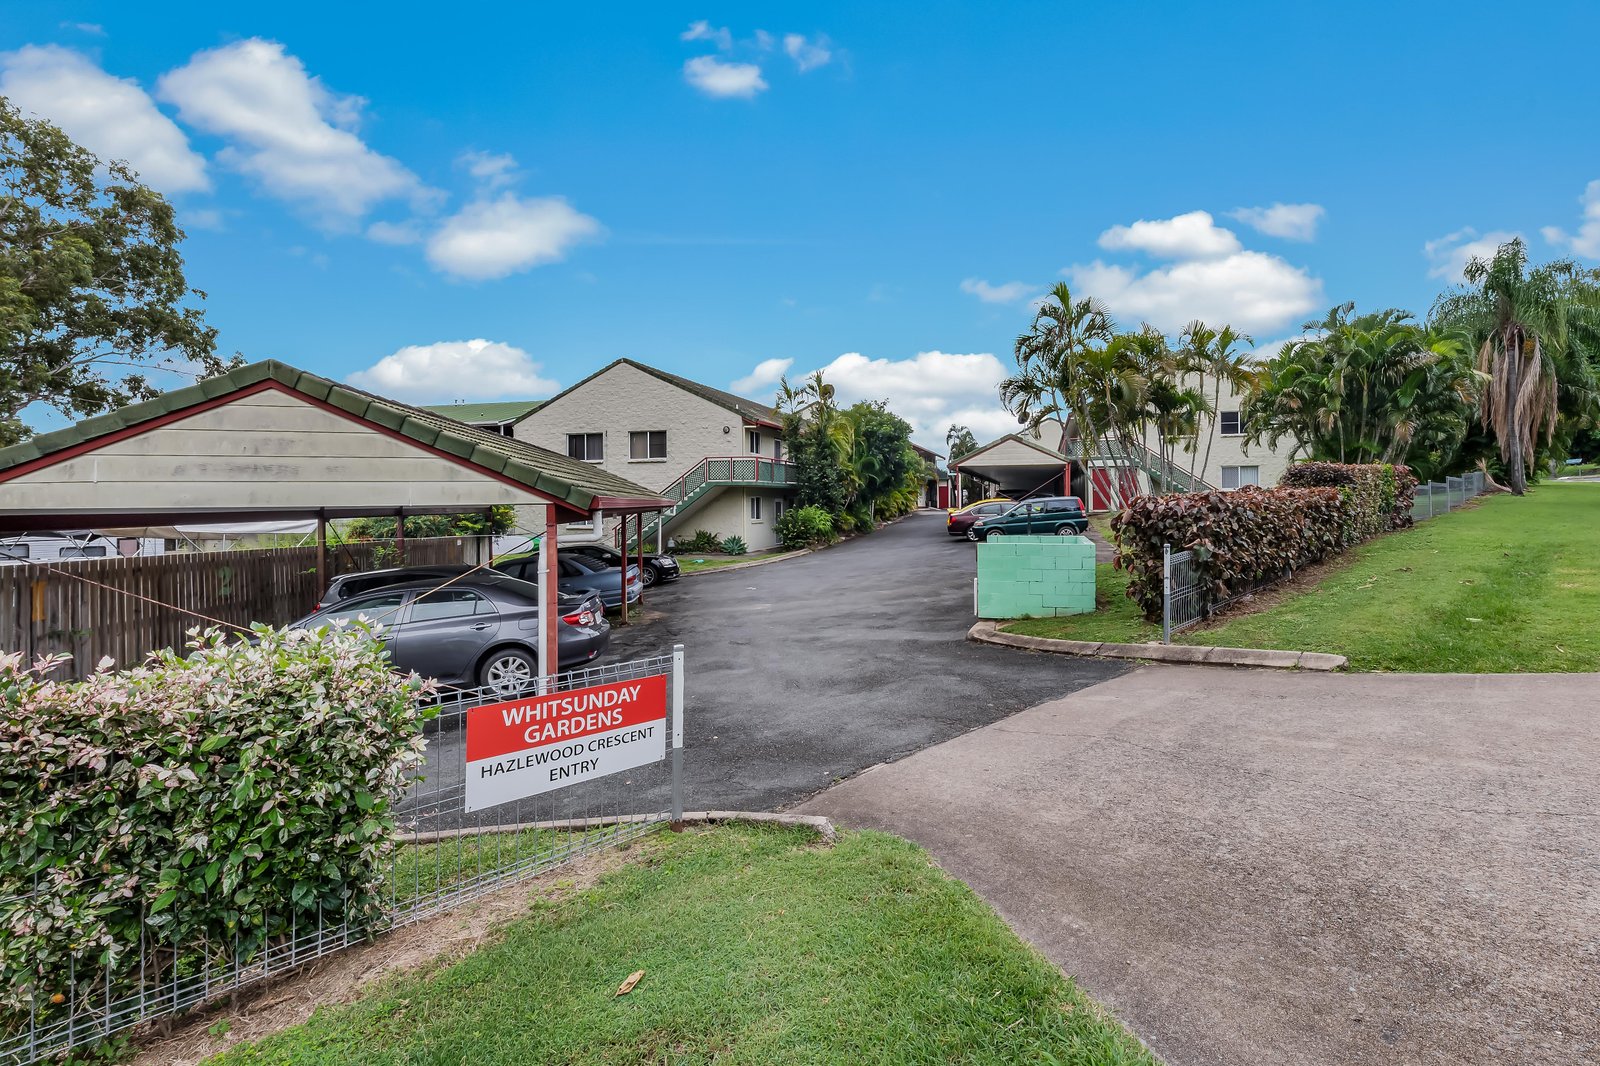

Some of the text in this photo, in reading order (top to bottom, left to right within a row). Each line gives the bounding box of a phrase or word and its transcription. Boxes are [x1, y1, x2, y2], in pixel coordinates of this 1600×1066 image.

[501, 685, 642, 727] WHITSUNDAY
[524, 708, 623, 743] GARDENS
[481, 726, 655, 779] HAZLEWOOD CRESCENT
[549, 757, 599, 782] ENTRY
